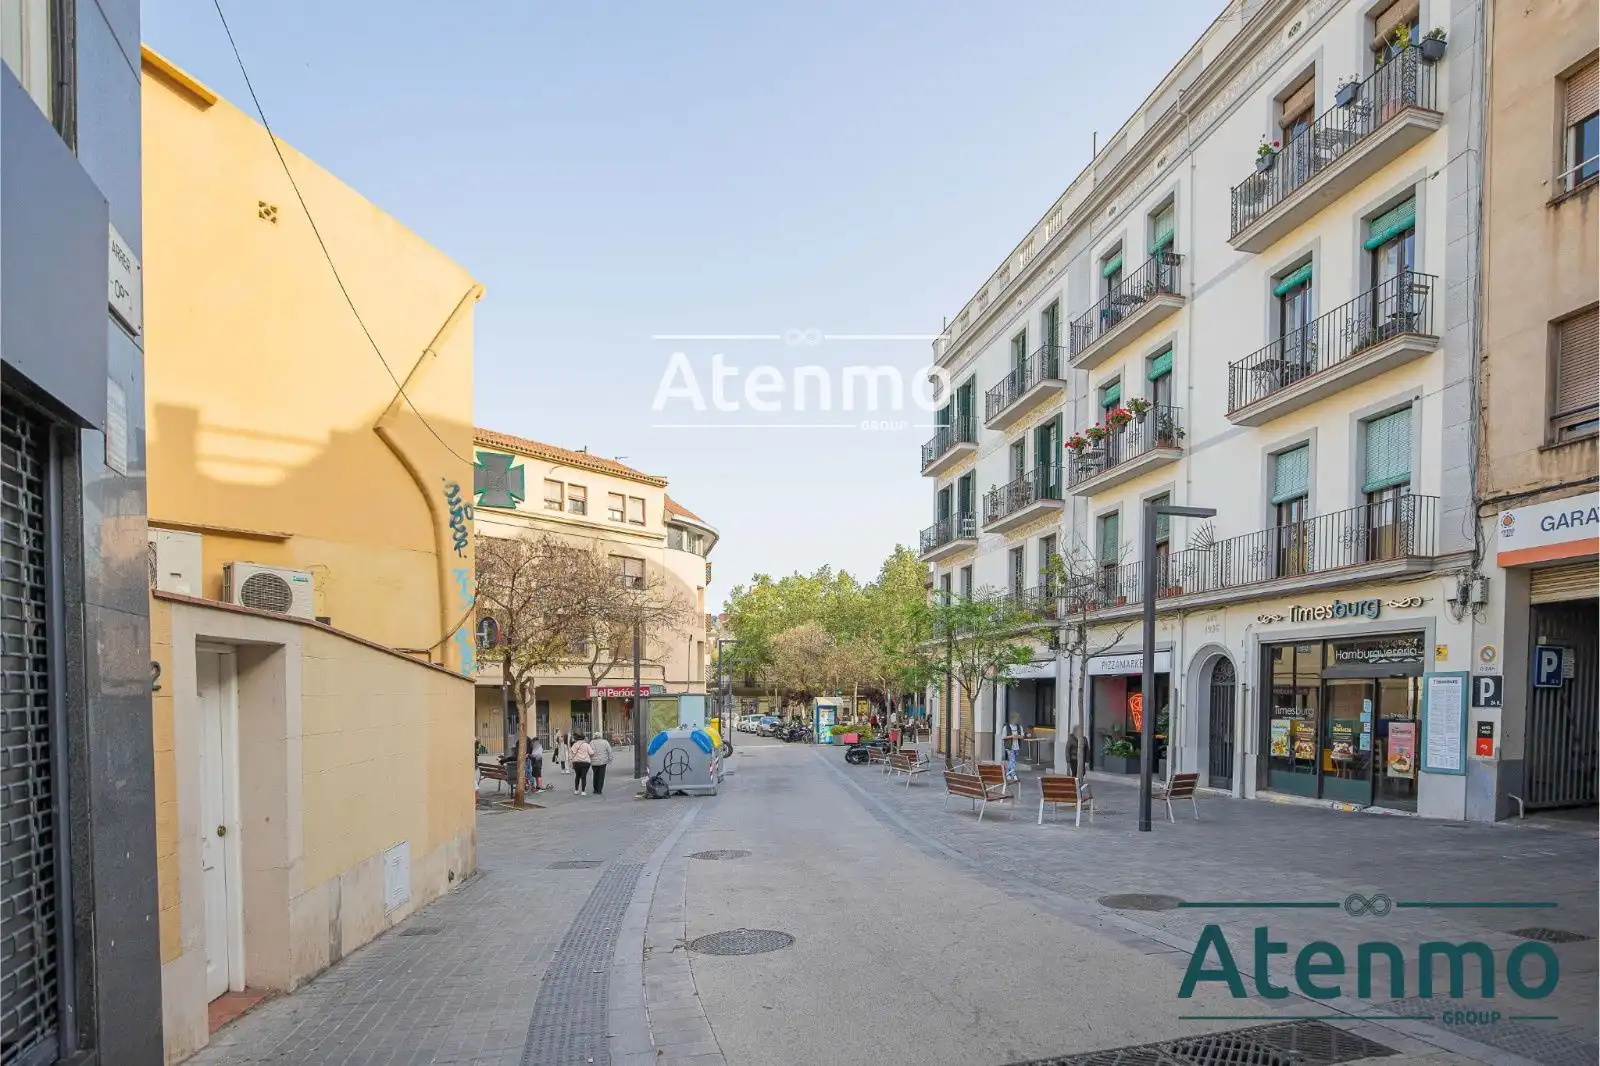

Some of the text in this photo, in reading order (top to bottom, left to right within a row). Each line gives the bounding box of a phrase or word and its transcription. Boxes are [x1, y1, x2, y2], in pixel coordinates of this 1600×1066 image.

[1541, 507, 1599, 532] GARA
[1288, 598, 1381, 622] Timesburg
[1541, 651, 1557, 682] P
[1480, 678, 1495, 706] P
[1275, 705, 1315, 718] Timesburg
